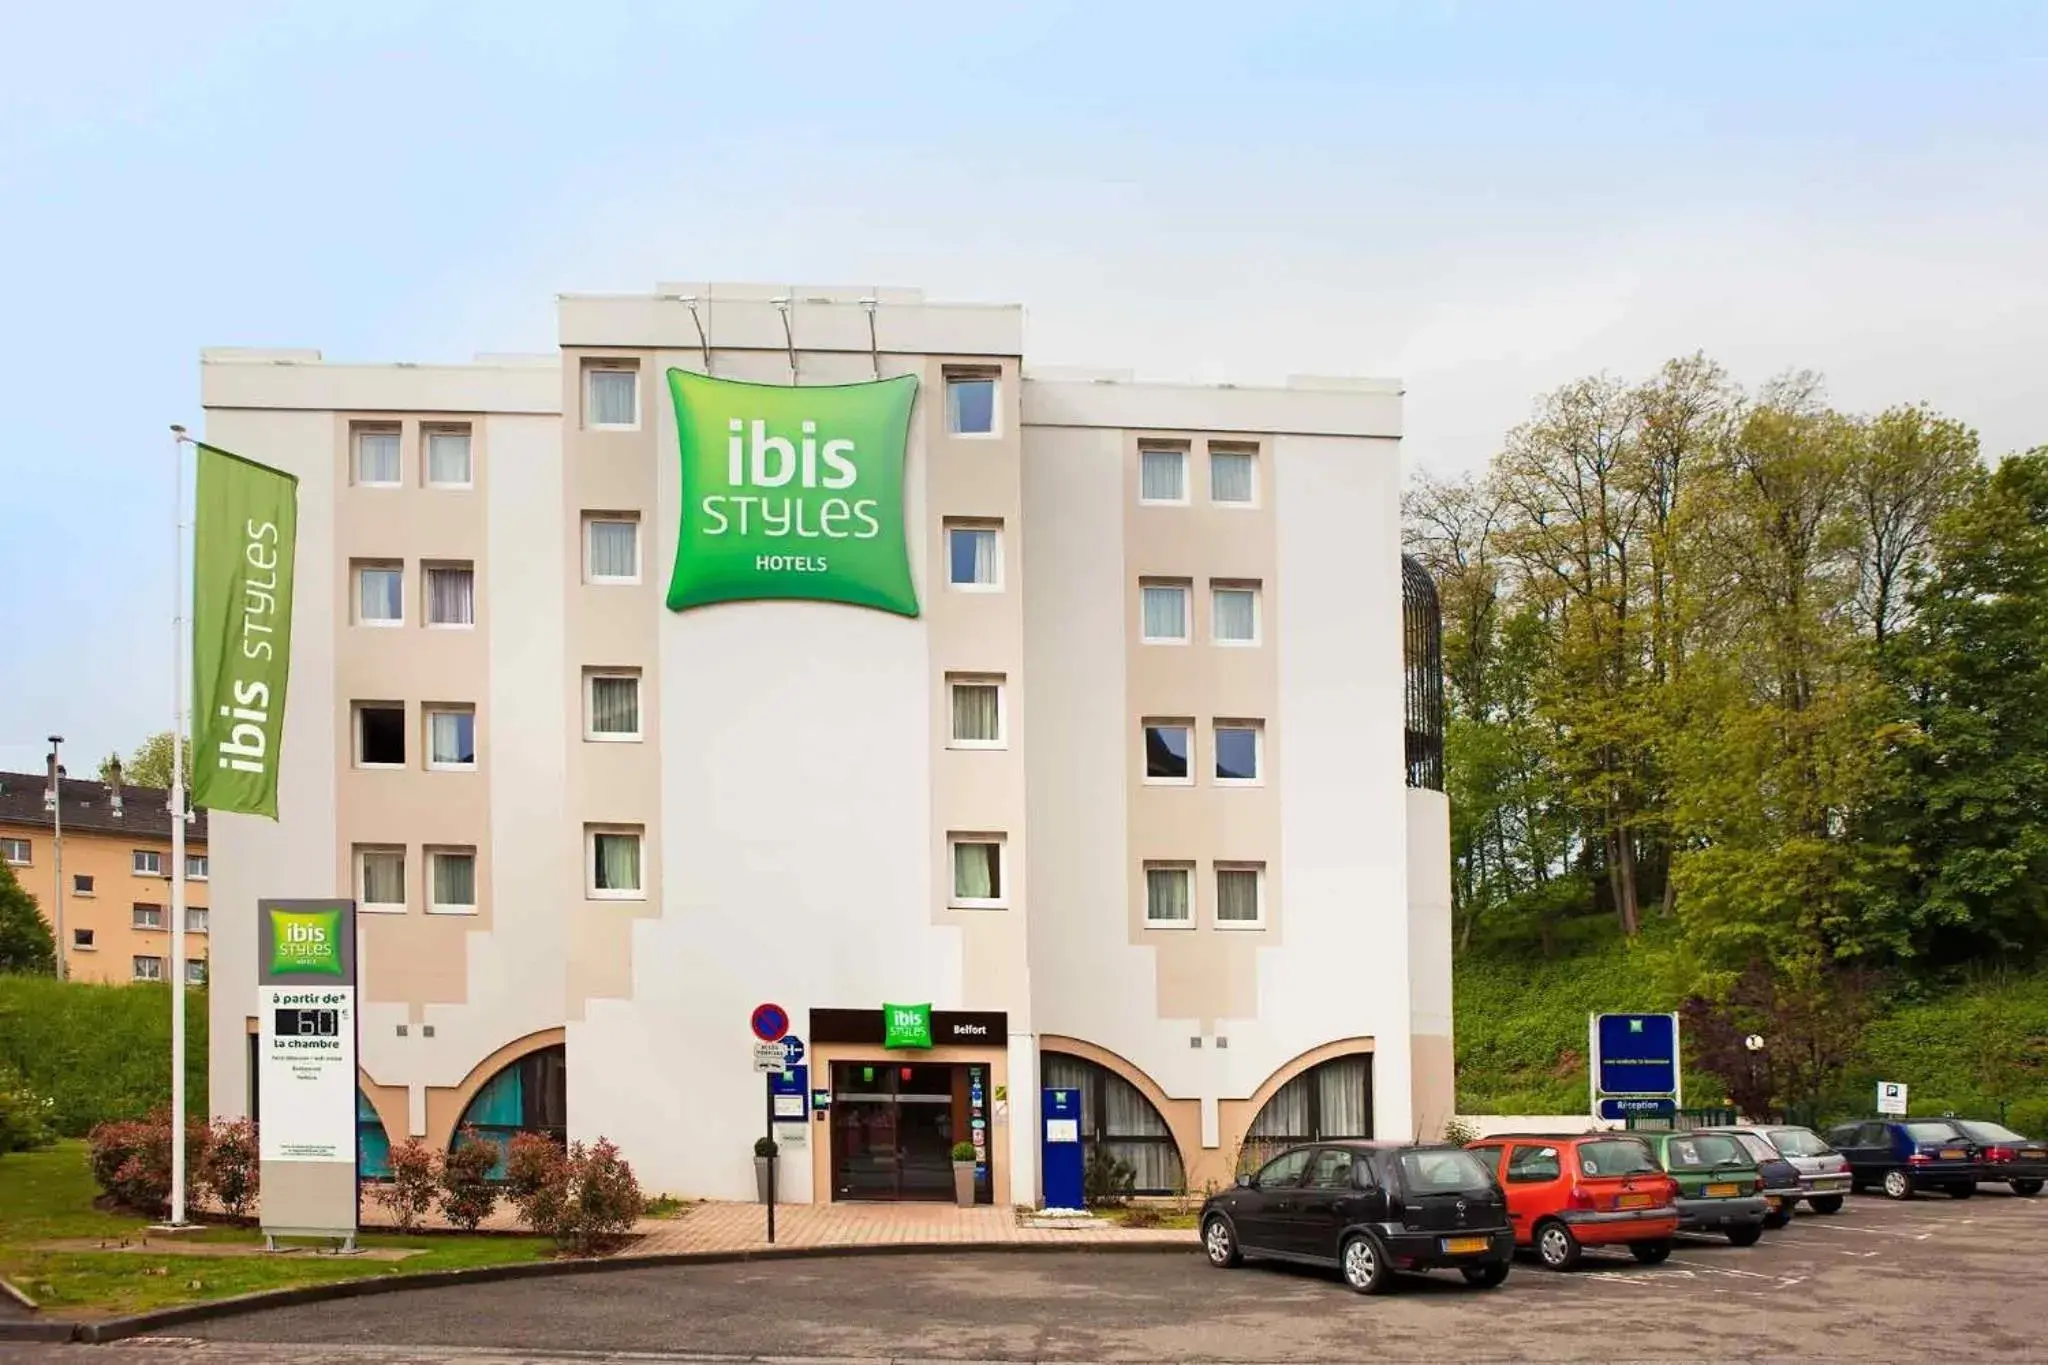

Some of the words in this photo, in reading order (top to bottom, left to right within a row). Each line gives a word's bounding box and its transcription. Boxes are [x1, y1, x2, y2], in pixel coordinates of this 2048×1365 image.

[728, 417, 857, 489] ibis
[756, 555, 828, 572] HOTELS
[219, 680, 270, 774] ibis
[287, 922, 325, 942] ibis
[272, 993, 280, 1004] à
[283, 994, 319, 1005] partir
[298, 1009, 335, 1036] 60
[894, 1010, 922, 1026] ibis
[953, 1024, 987, 1035] Belfort
[274, 1039, 285, 1048] la
[288, 1039, 340, 1048] chambre
